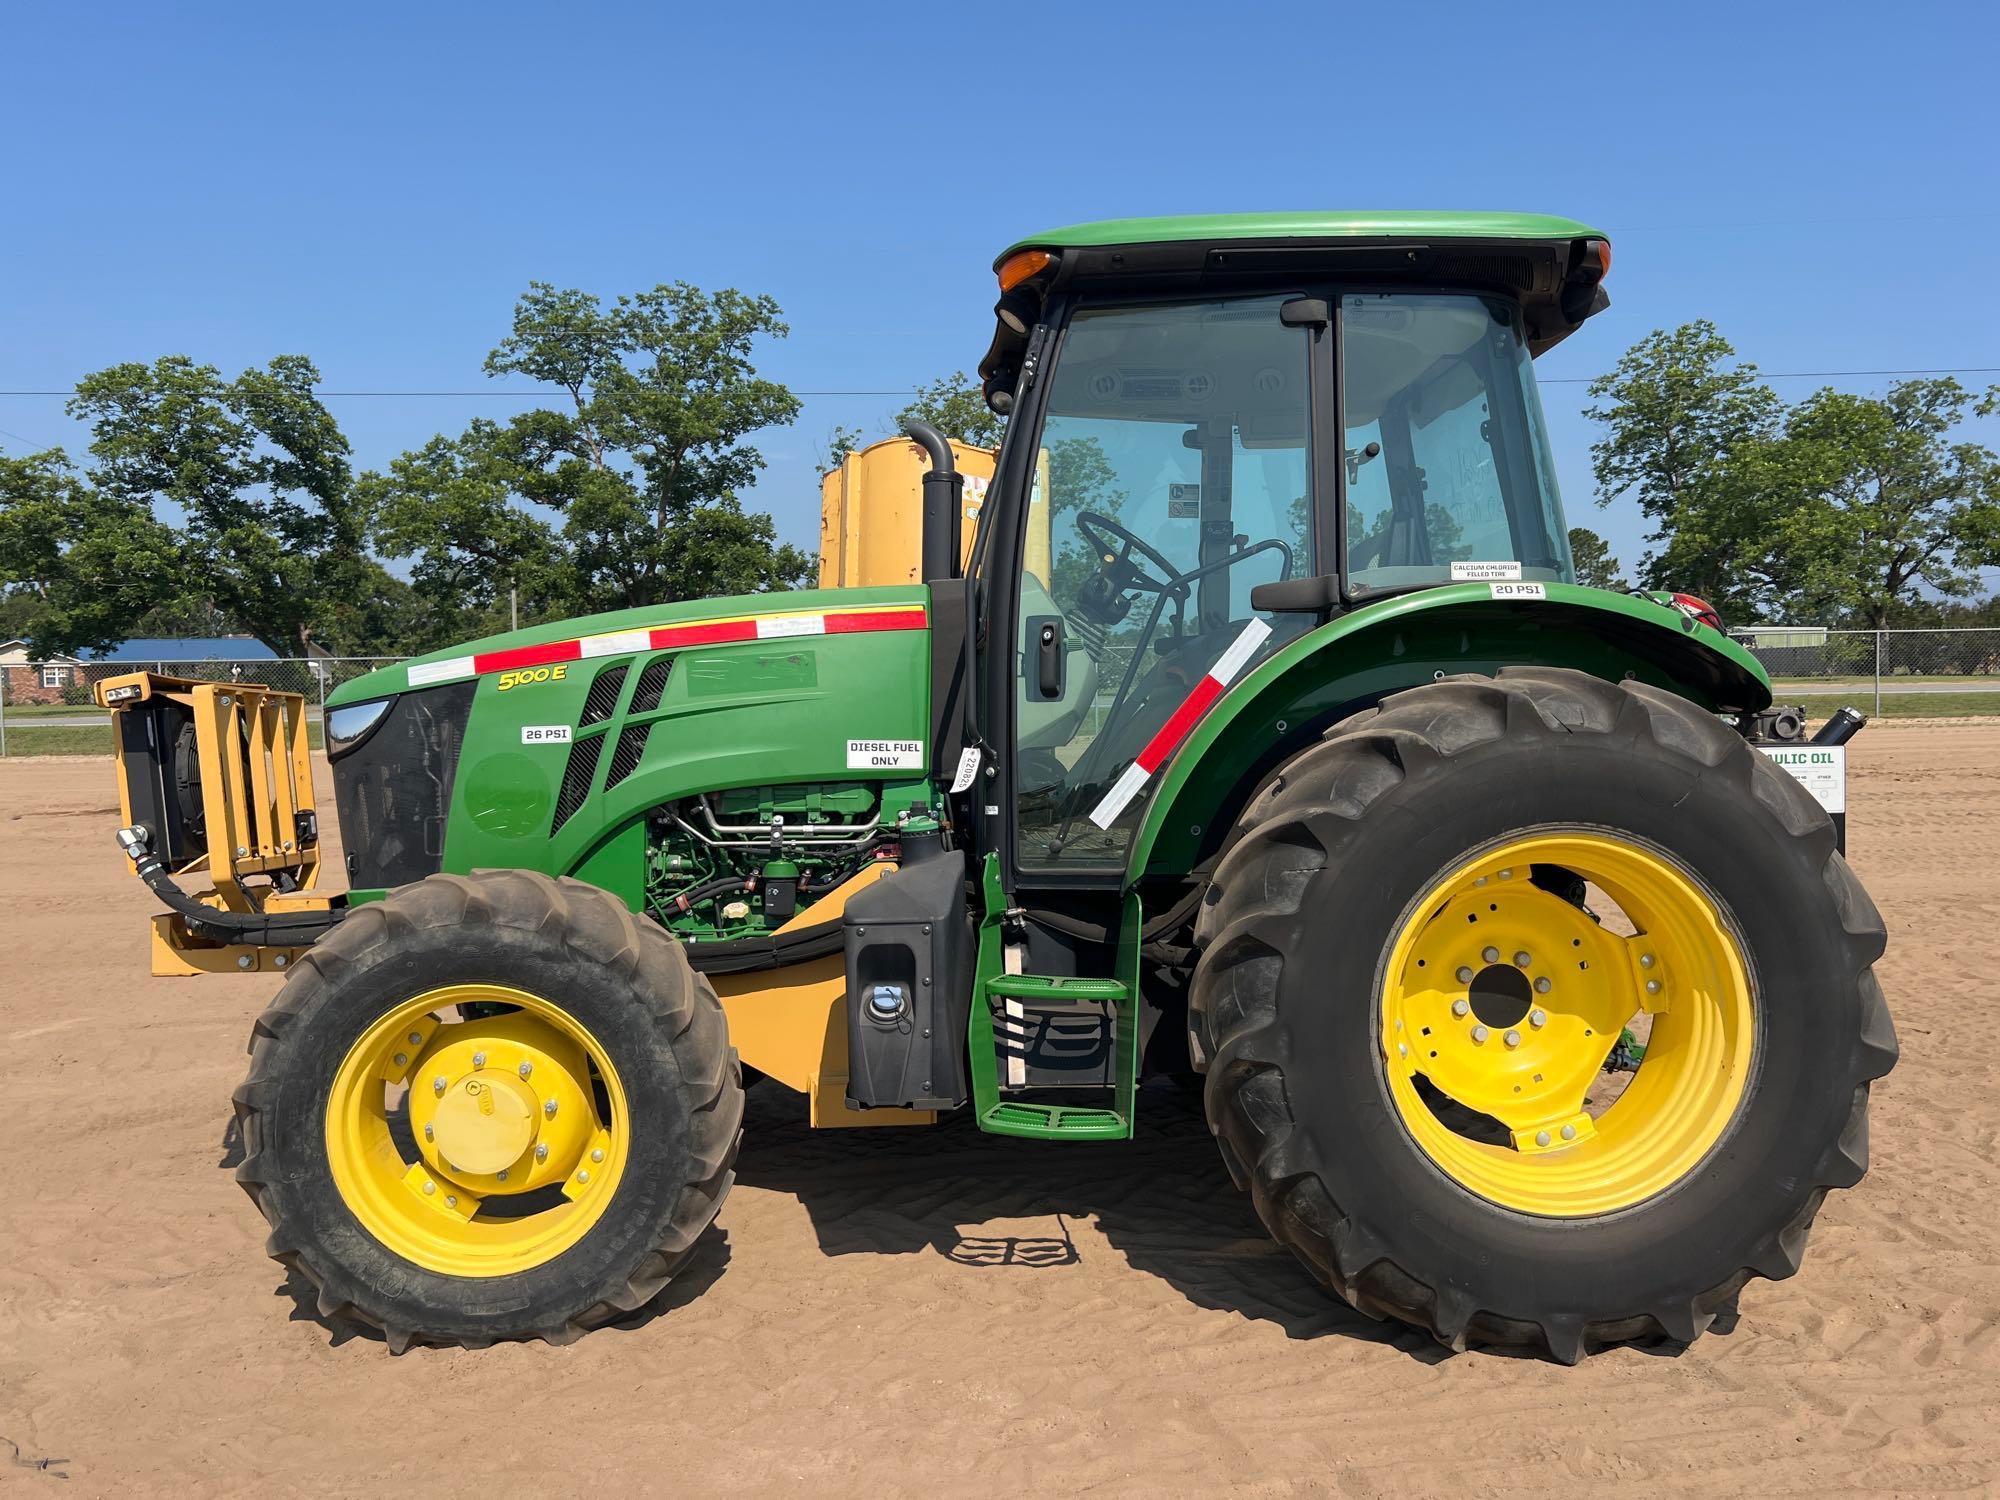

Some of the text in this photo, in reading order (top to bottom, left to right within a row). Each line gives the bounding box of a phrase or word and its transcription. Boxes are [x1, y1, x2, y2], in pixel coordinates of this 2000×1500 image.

[1495, 585, 1541, 594] 20 PSI
[551, 664, 568, 681] E
[526, 729, 567, 740] 26 PSI
[850, 742, 920, 752] DIESEL FUEL
[871, 756, 899, 766] ONLY
[1811, 752, 1835, 764] OIL
[958, 757, 977, 788] 220825
